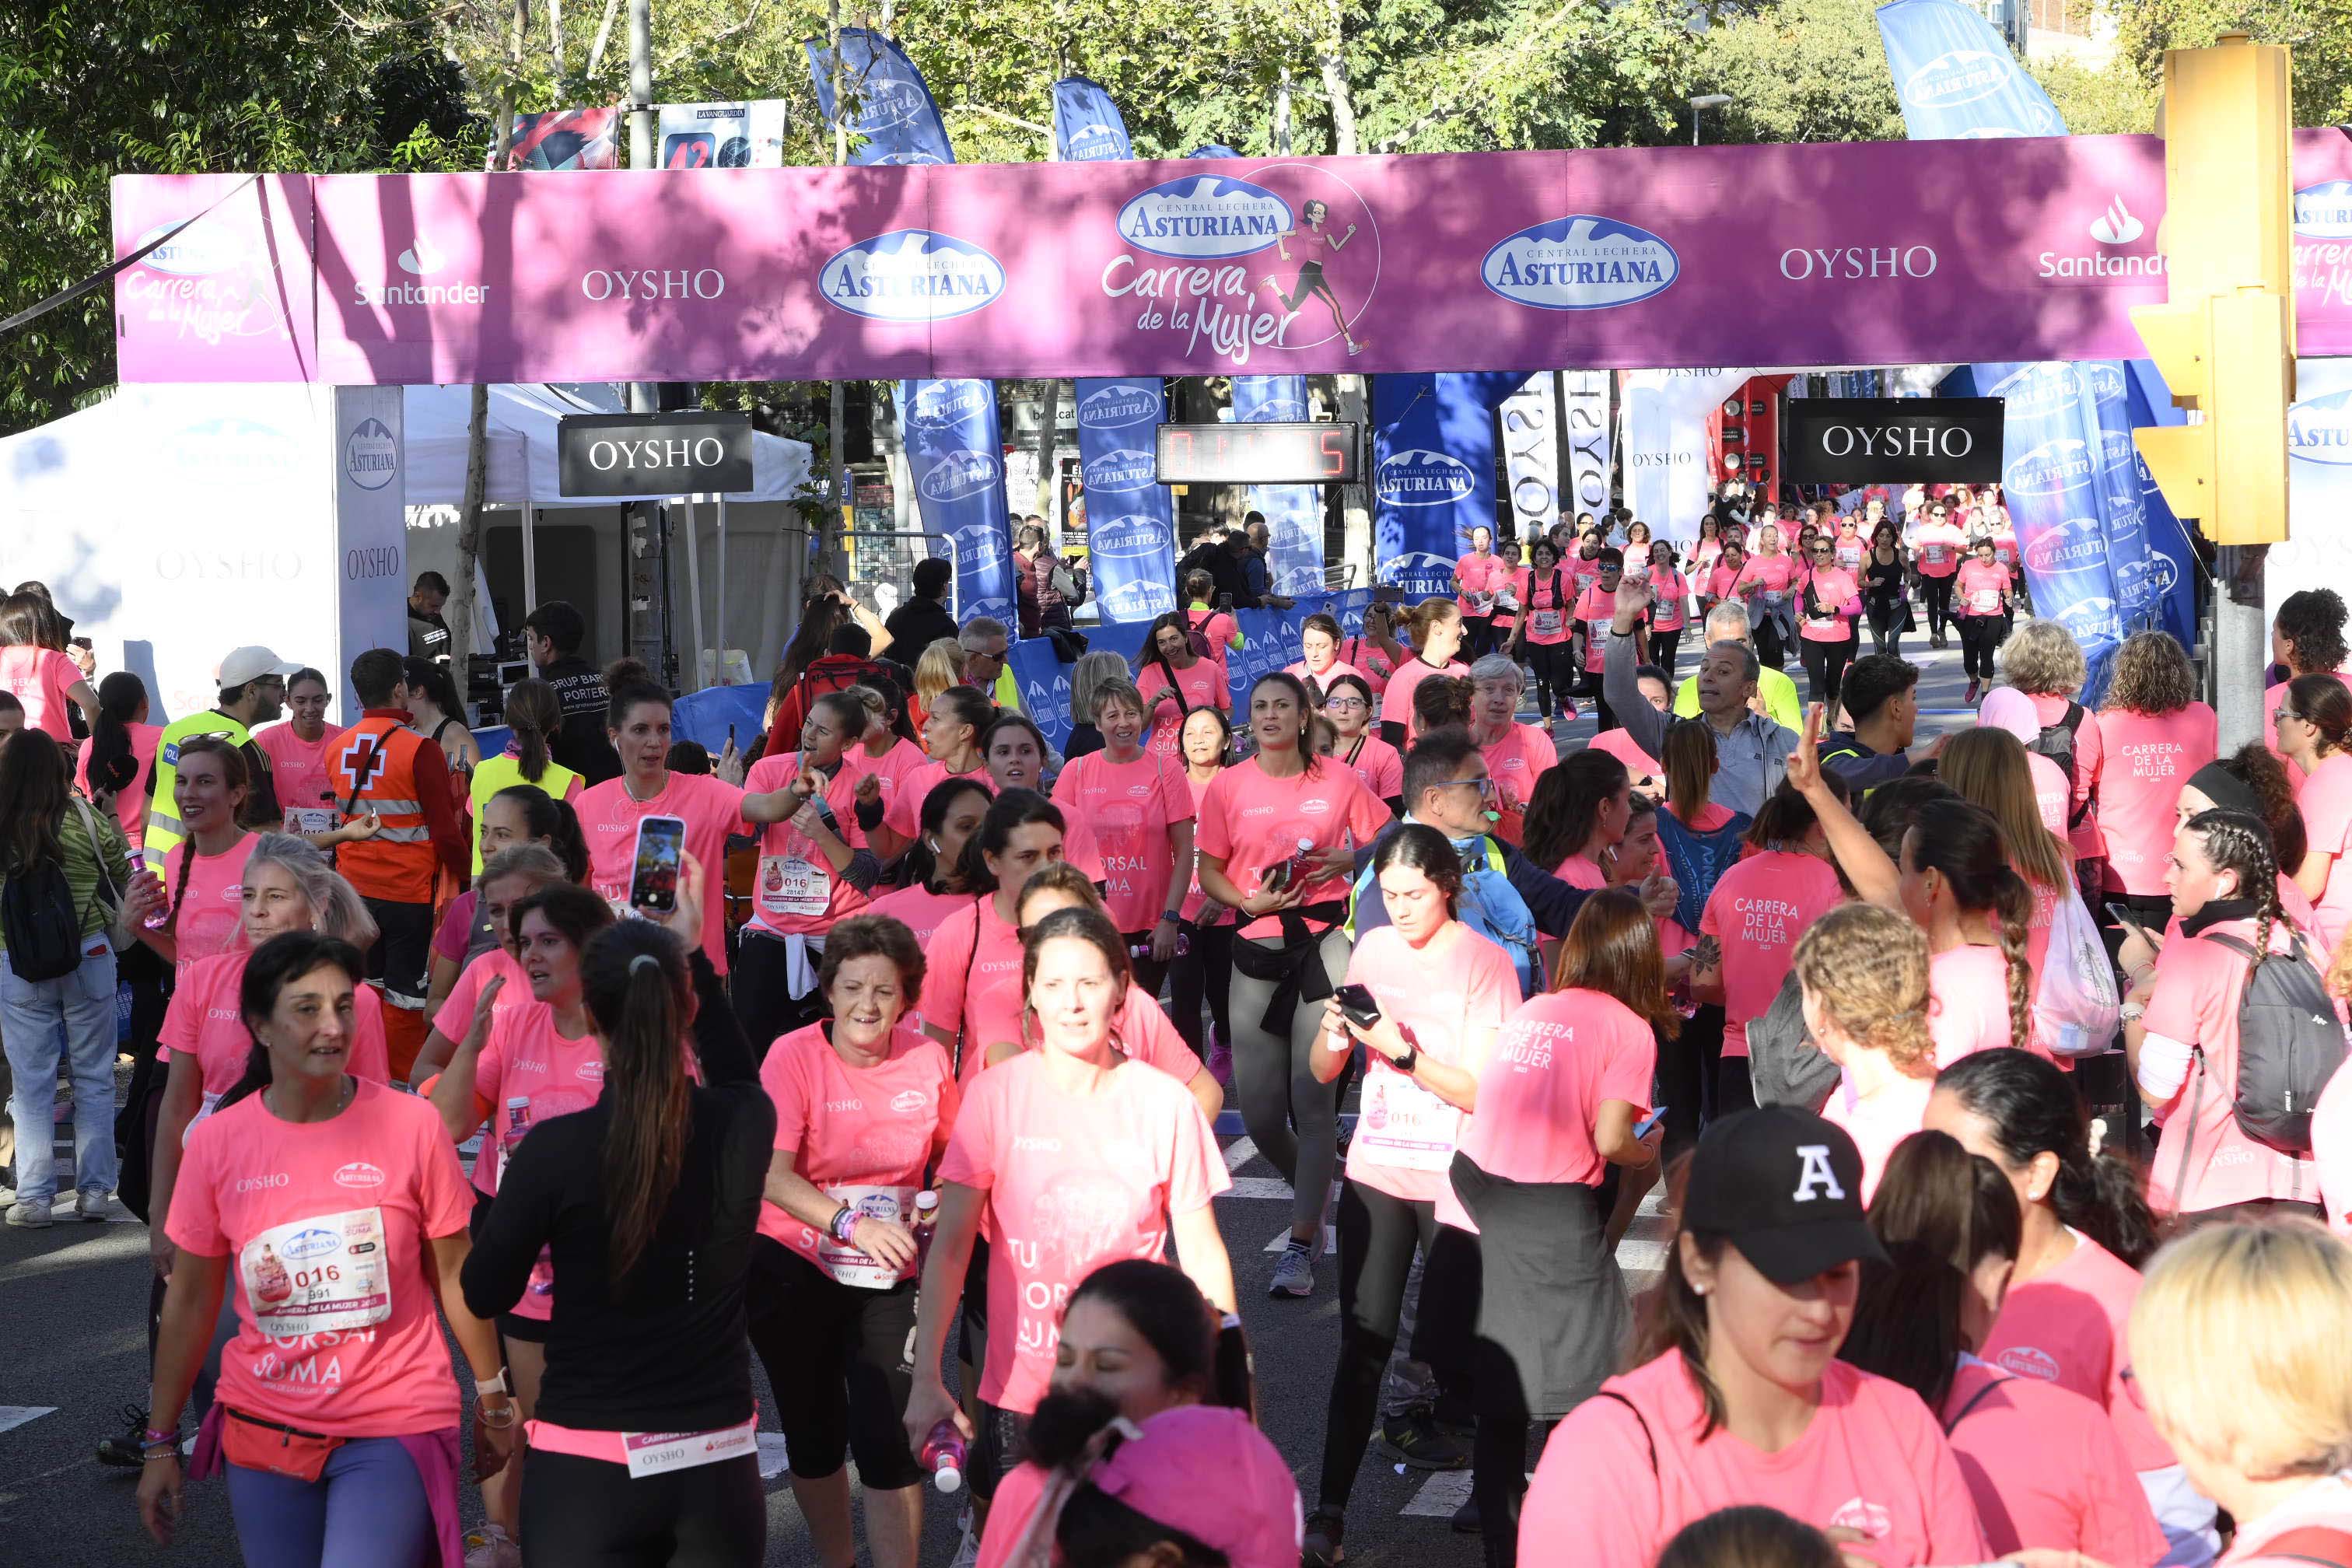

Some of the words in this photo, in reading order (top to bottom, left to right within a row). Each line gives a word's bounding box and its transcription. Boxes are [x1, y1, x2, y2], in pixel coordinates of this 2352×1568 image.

[707, 109, 745, 118] VANGUARDIA
[1157, 203, 1211, 212] CENTRAL
[1217, 202, 1275, 212] LECHERA
[1130, 206, 1279, 238] ASTURIANA
[1527, 249, 1587, 258] CENTRAL
[1594, 247, 1657, 256] LECHERA
[1496, 251, 1664, 286] ASTURIANA
[1780, 245, 1937, 280] OYSHO
[2039, 251, 2168, 278] Santand
[582, 268, 725, 301] OYSHO
[1101, 254, 1248, 298] Carrera
[354, 281, 490, 306] Santander
[1137, 300, 1164, 330] de
[1170, 298, 1189, 330] la
[1185, 292, 1302, 366] Mujer
[1822, 425, 1973, 457] OYSHO
[348, 445, 394, 473] ASTURIANA
[588, 436, 724, 471] OYSHO
[1633, 453, 1692, 467] OYSHO
[1379, 472, 1468, 494] ASTURIANA
[348, 546, 399, 580] OYSHO
[549, 677, 579, 690] GRUP
[2122, 743, 2184, 757] CARRERA
[2134, 755, 2153, 766] DE
[2157, 754, 2172, 765] LA
[2133, 765, 2175, 777] MUJER
[1243, 806, 1273, 817] OYSHO
[597, 824, 630, 833] OYSHO
[785, 877, 807, 887] 016
[1104, 877, 1132, 891] MA
[1734, 898, 1799, 920] CARRERA
[1745, 914, 1765, 928] DE
[1767, 915, 1785, 929] LA
[1741, 927, 1787, 944] MUJER
[1504, 1020, 1574, 1042] CARRERA
[1510, 1033, 1532, 1050] DE
[1535, 1034, 1552, 1051] LA
[1501, 1045, 1552, 1069] MUJER
[1793, 1144, 1846, 1202] A
[236, 1173, 289, 1192] OYSHO
[859, 1202, 898, 1213] ASTURIANA
[829, 1256, 859, 1265] CARRERA
[1007, 1237, 1037, 1269] TU
[296, 1265, 341, 1288] 016
[309, 1288, 331, 1300] 991
[275, 1306, 306, 1314] ARRERA
[308, 1304, 319, 1313] DE
[320, 1304, 331, 1312] LA
[331, 1301, 359, 1311] MUJER
[271, 1322, 309, 1332] OYSHO
[253, 1353, 341, 1384] SUMA
[642, 1448, 685, 1465] OYSHO
